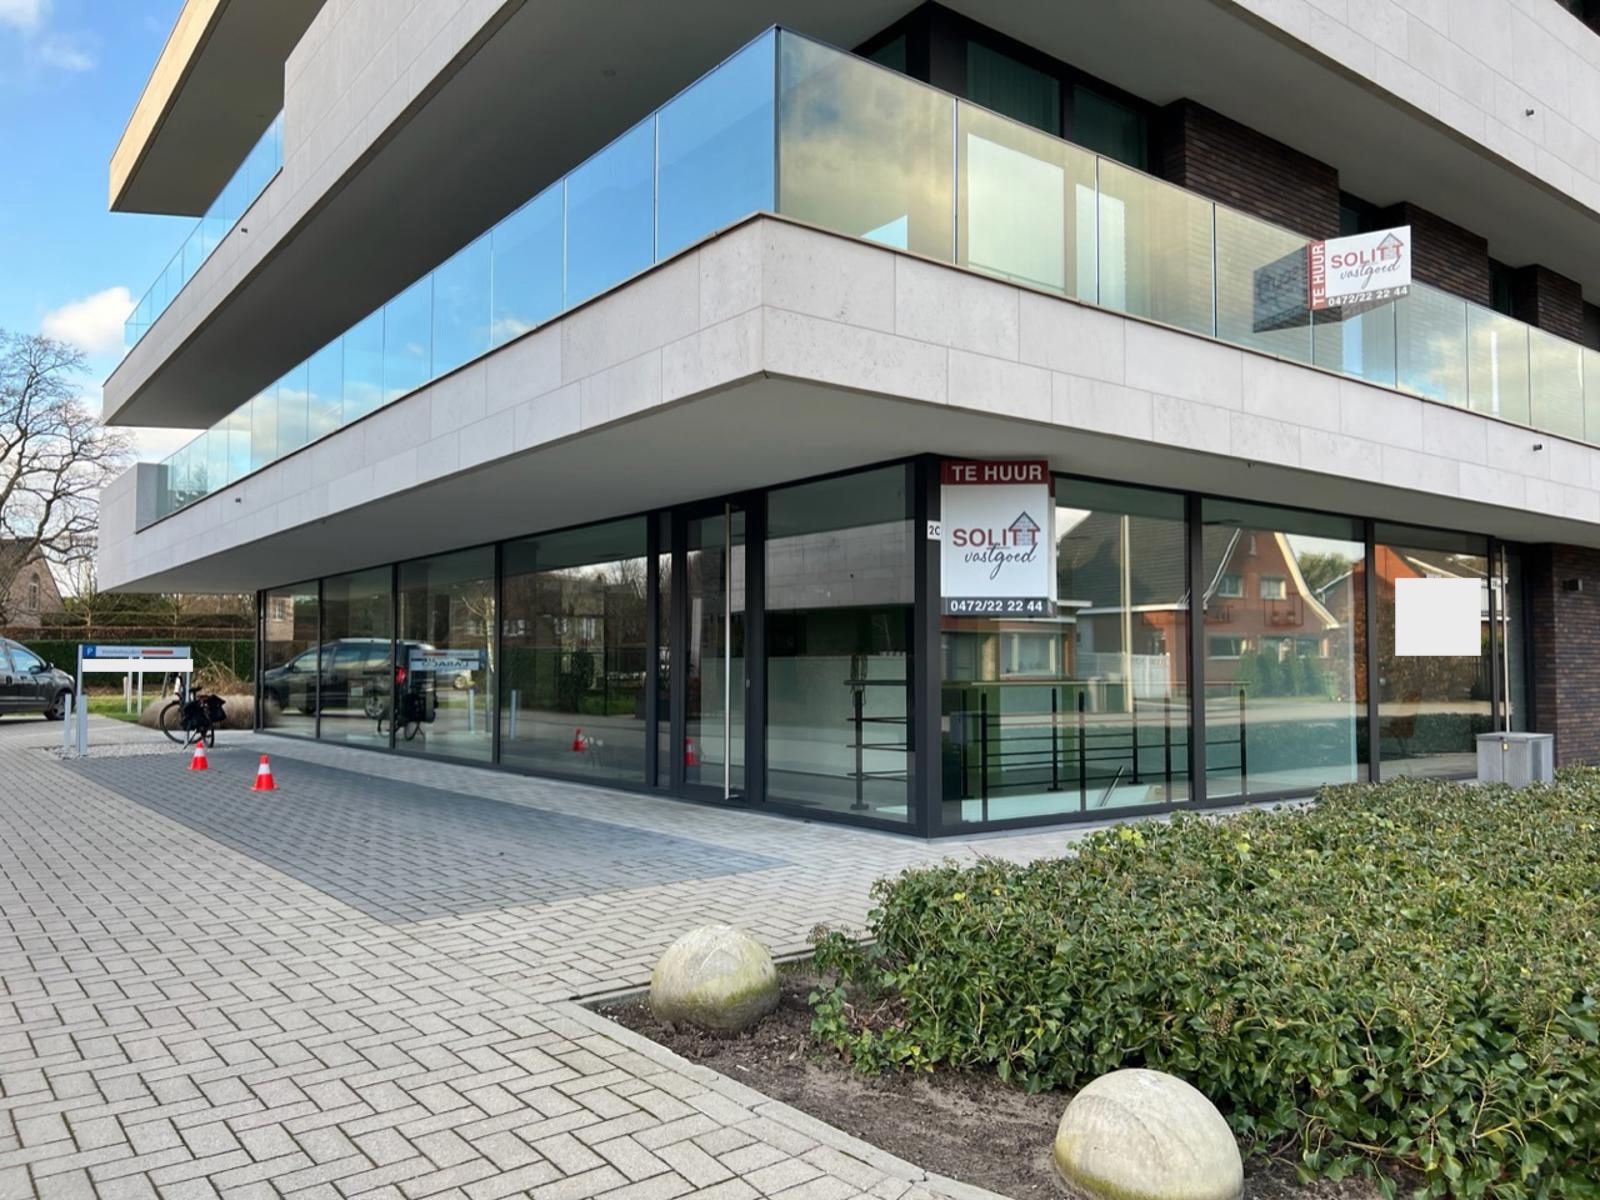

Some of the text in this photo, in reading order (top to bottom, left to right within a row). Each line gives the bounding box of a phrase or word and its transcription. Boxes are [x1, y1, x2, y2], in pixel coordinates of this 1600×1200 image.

[1312, 244, 1325, 306] TE HUUR
[1340, 256, 1400, 289] vastgoed
[1328, 293, 1372, 307] 0472/22
[1376, 290, 1390, 299] 22
[1394, 287, 1408, 296] 44
[952, 465, 1042, 481] TE HUUR
[952, 528, 1040, 548] SOLITT
[964, 542, 1038, 580] vastgoed
[950, 600, 1043, 612] 0472/22 22 44
